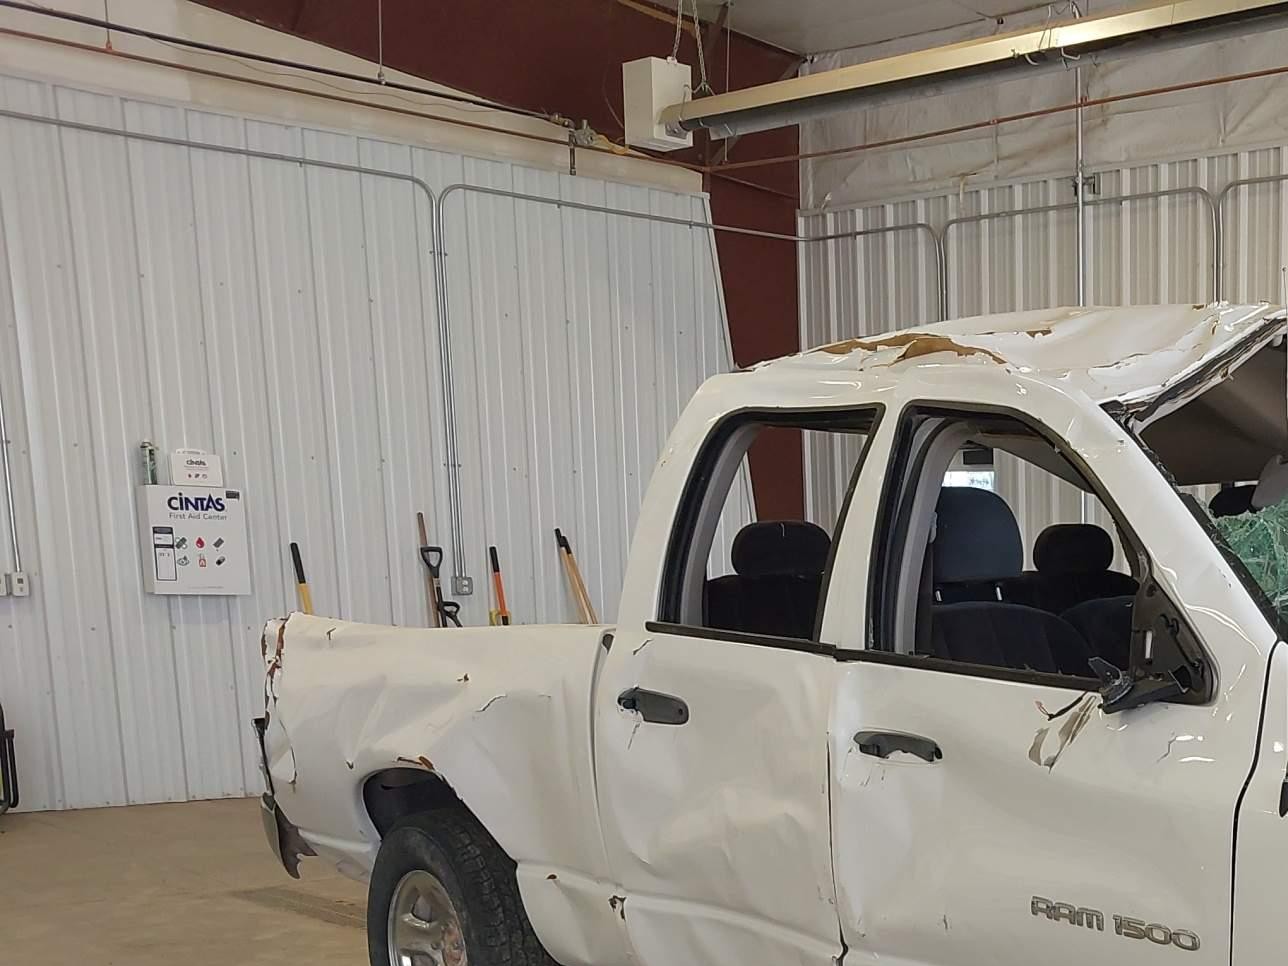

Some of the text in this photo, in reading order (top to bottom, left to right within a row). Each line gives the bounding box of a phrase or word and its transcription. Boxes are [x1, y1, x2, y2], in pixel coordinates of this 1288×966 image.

[169, 512, 186, 520] First
[203, 513, 227, 521] Center
[1031, 896, 1201, 951] RAM 1500
